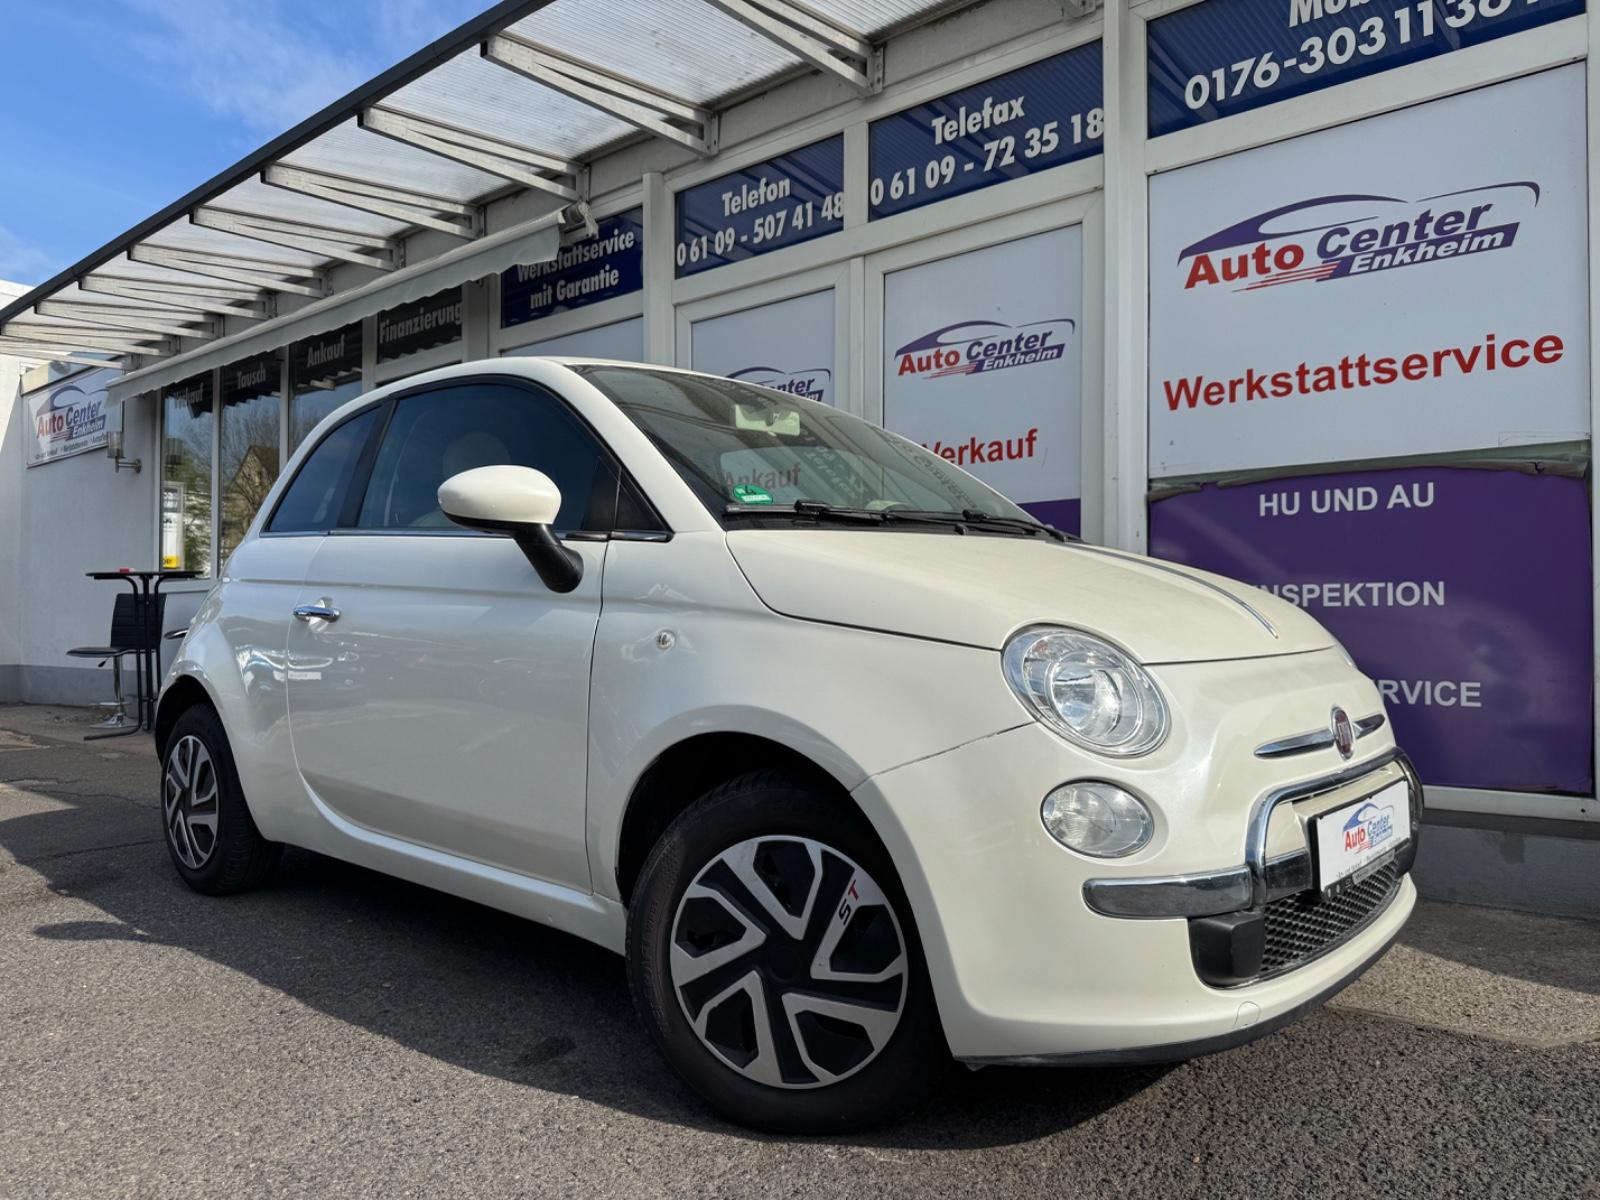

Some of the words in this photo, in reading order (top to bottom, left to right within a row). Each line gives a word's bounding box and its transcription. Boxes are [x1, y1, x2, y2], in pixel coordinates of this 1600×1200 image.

[931, 96, 1025, 146] Telefax
[870, 178, 884, 206] 0
[890, 167, 916, 200] 61
[925, 155, 955, 189] 09
[983, 135, 1015, 172] 72
[1024, 121, 1059, 158] 35
[1071, 107, 1104, 144] 18
[722, 177, 790, 217] Telefon
[676, 243, 687, 266] 0
[690, 235, 708, 262] 61
[714, 227, 735, 255] 09
[753, 209, 787, 244] 507
[792, 201, 813, 230] 41
[821, 192, 844, 221] 48
[1184, 242, 1304, 290] Auto
[1316, 203, 1493, 259] Center
[517, 228, 635, 282] Werkstattservice
[1349, 230, 1505, 274] Enkheim
[530, 284, 552, 310] mit
[556, 264, 619, 301] Garantie
[379, 303, 463, 344] Finanzierung
[307, 334, 345, 368] Ankauf
[897, 347, 960, 376] Auto
[966, 331, 1053, 361] Center
[982, 349, 1058, 371] Enkheim
[236, 361, 266, 389] Tausch
[771, 378, 815, 393] nter
[1163, 334, 1564, 411] Werkstattservice
[37, 412, 64, 439] Auto
[66, 400, 102, 426] Center
[1259, 492, 1300, 517] HU
[1311, 486, 1378, 513] UND
[1386, 482, 1434, 509] AU
[1253, 581, 1445, 607] NSPEKTION
[1373, 680, 1482, 707] RVICE
[1345, 826, 1365, 852] Auto
[839, 880, 858, 926] ST
